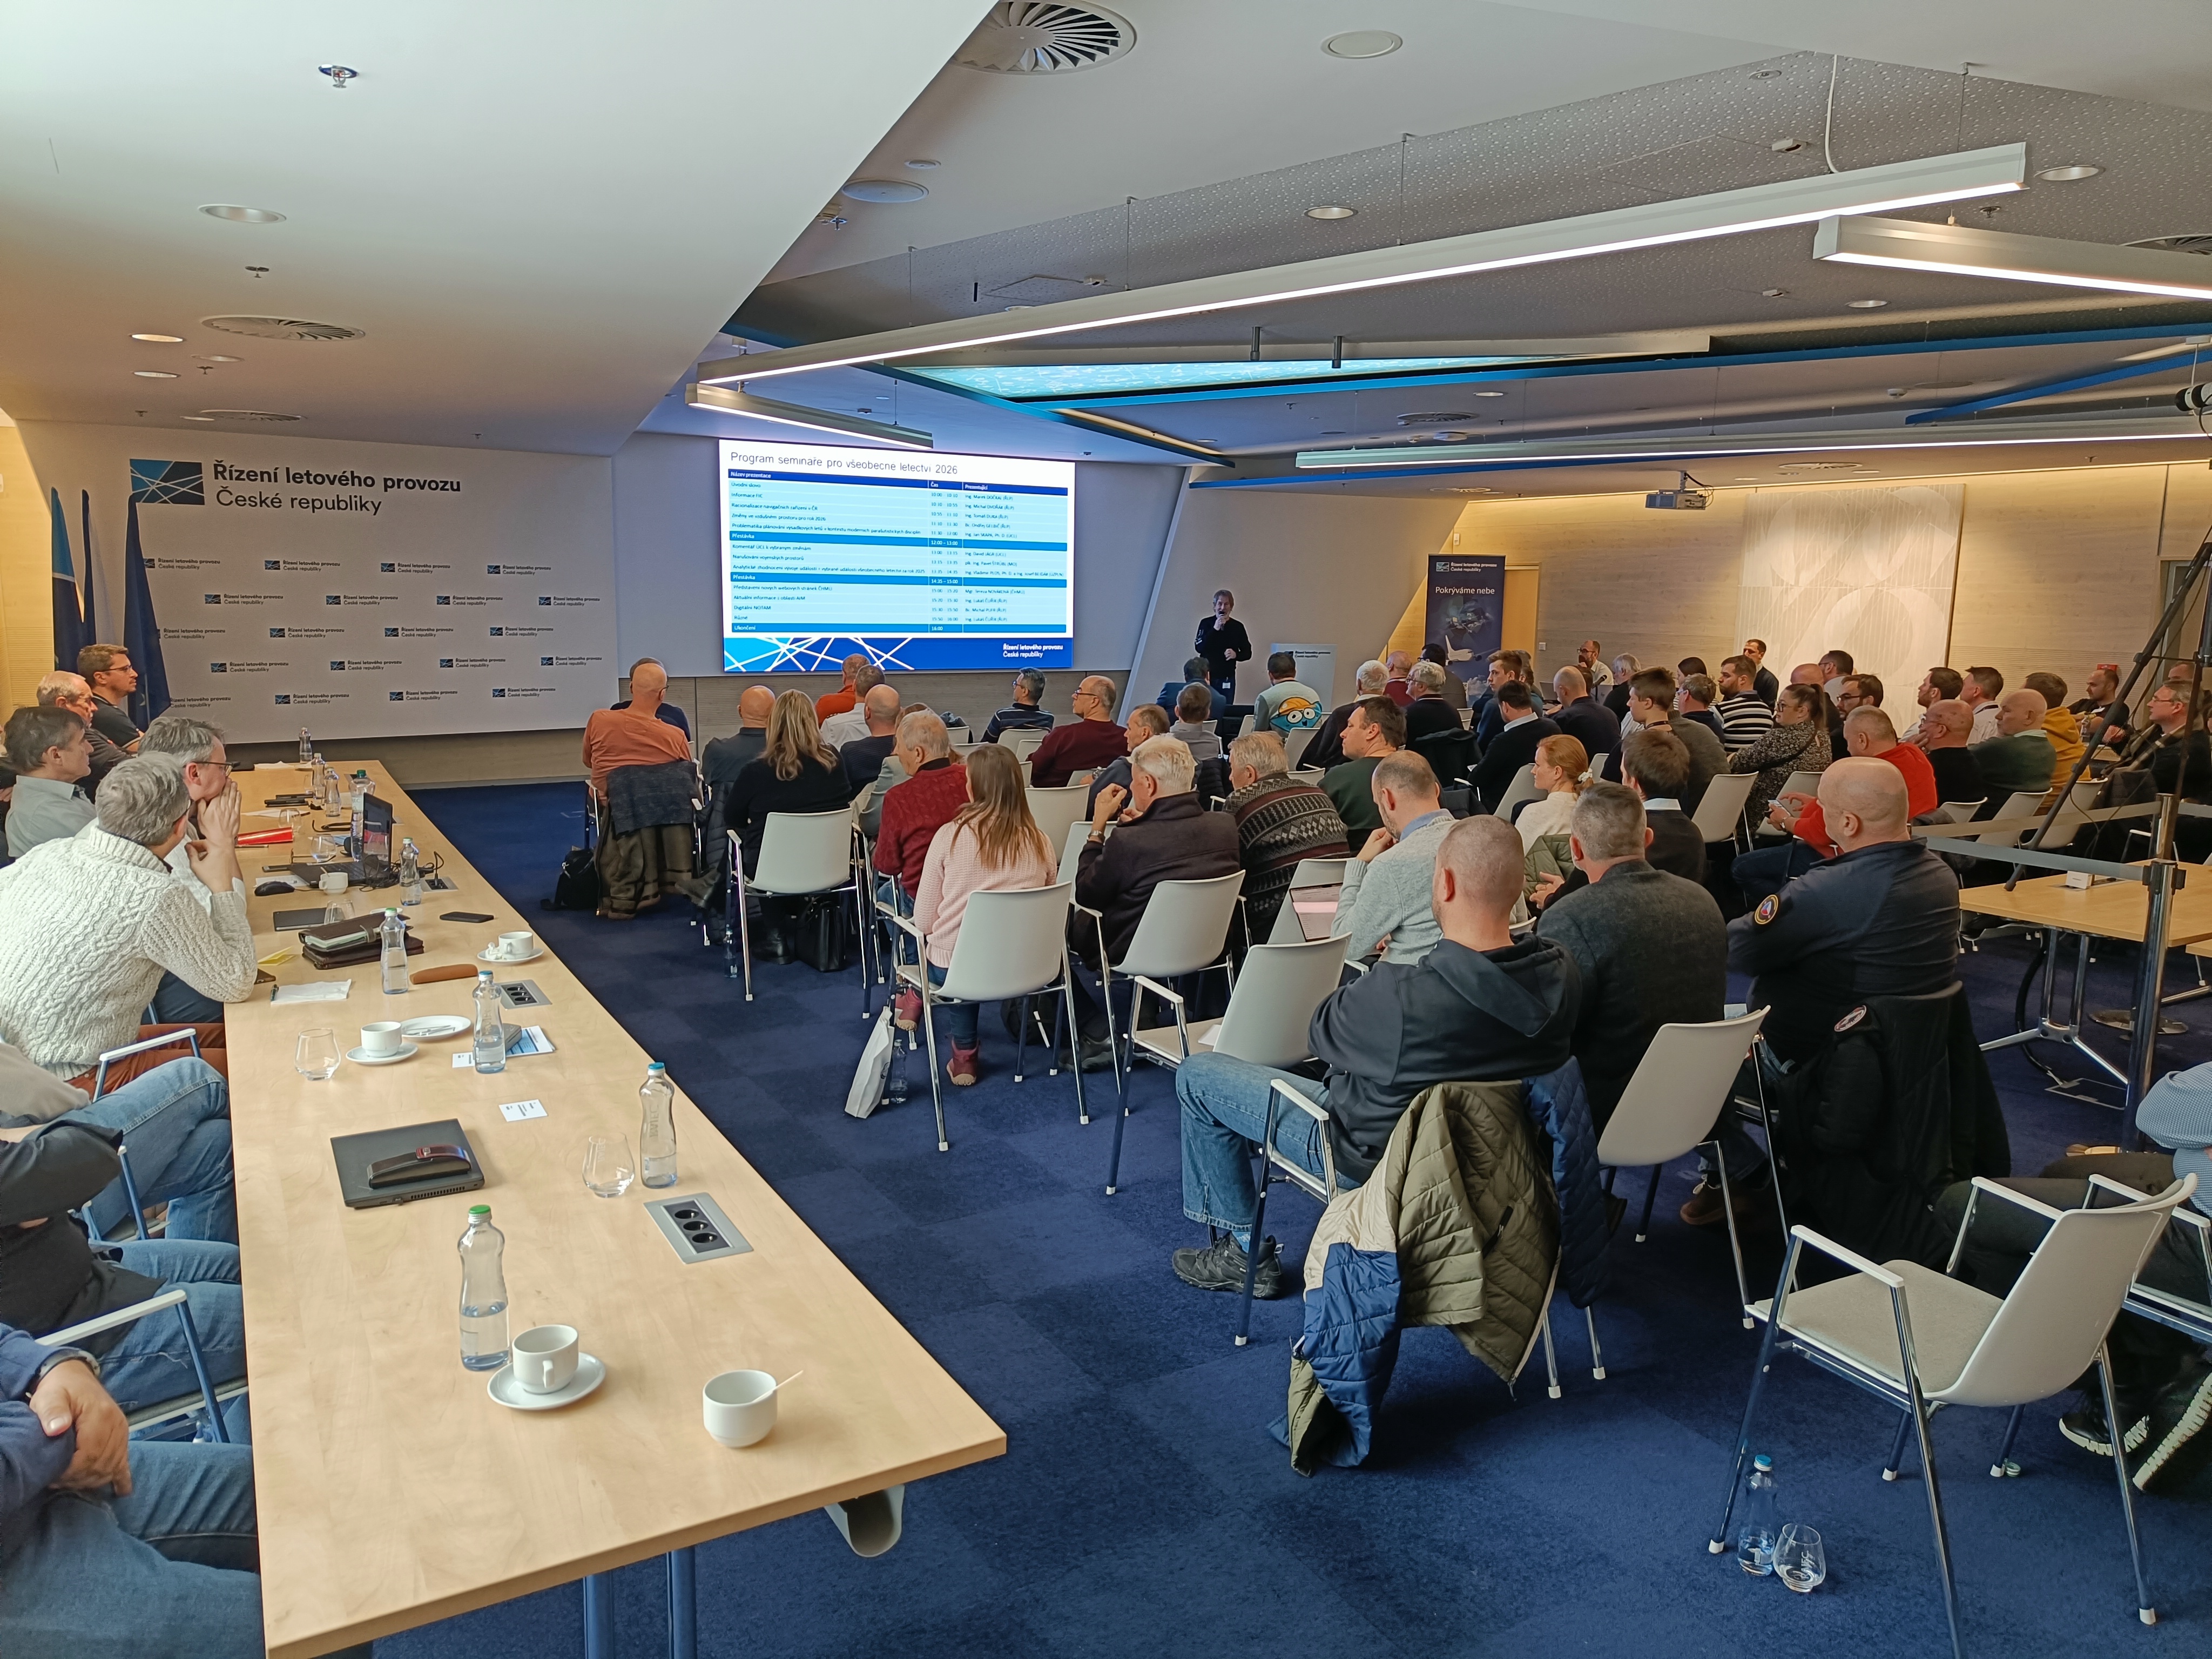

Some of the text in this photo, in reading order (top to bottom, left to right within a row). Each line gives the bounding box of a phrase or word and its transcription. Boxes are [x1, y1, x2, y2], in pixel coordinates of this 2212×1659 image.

[731, 452, 774, 465] Program
[827, 460, 842, 468] pro
[935, 464, 957, 474] 2026
[213, 460, 461, 493] Řízení letového provozu
[216, 485, 382, 516] České republiky
[1435, 586, 1475, 595] Pokrýváme
